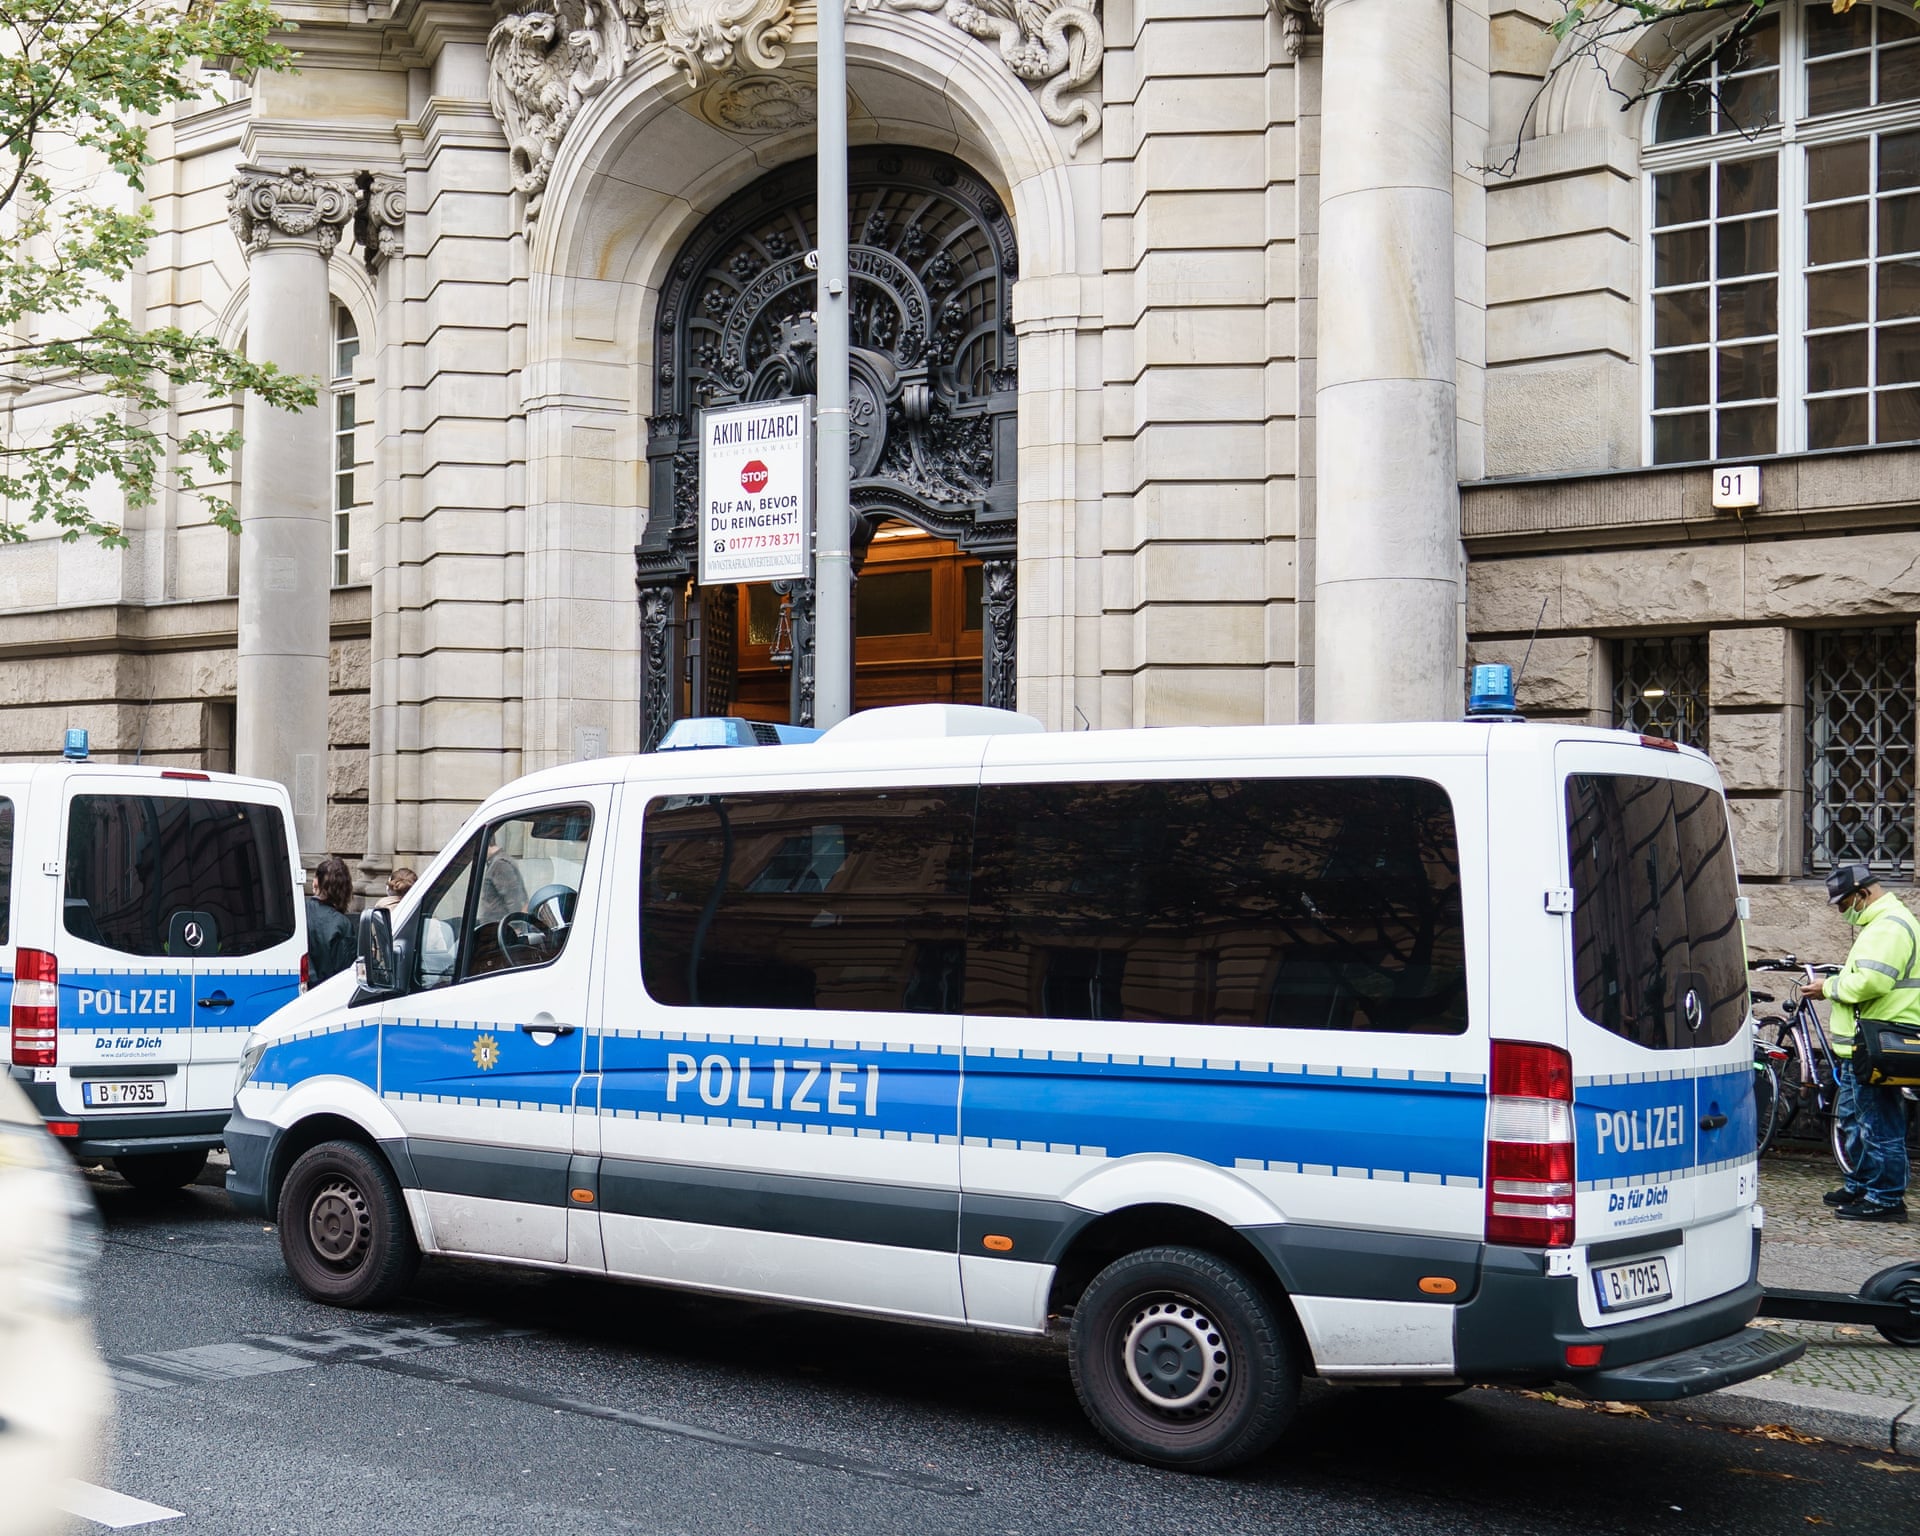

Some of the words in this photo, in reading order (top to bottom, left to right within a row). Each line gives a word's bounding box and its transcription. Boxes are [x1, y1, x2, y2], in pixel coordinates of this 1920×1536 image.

[713, 421, 742, 446] AKIN
[747, 414, 798, 441] HIZARCI
[742, 471, 767, 484] STOP
[1721, 474, 1742, 496] 91
[760, 495, 797, 510] BEVOR
[731, 508, 798, 530] REINGEHST!
[78, 989, 176, 1015] POLIZEI
[95, 1037, 112, 1048] Da
[115, 1037, 133, 1048] für
[135, 1037, 162, 1048] Dich
[99, 1085, 109, 1102] B
[120, 1084, 154, 1101] 7935
[666, 1053, 879, 1117] POLIZEI
[1595, 1105, 1684, 1154] POLIZEI
[1608, 1193, 1624, 1212] Da
[1627, 1188, 1644, 1209] für
[1645, 1185, 1668, 1206] Dich
[1610, 1272, 1622, 1300] B
[1629, 1264, 1660, 1297] 7915
